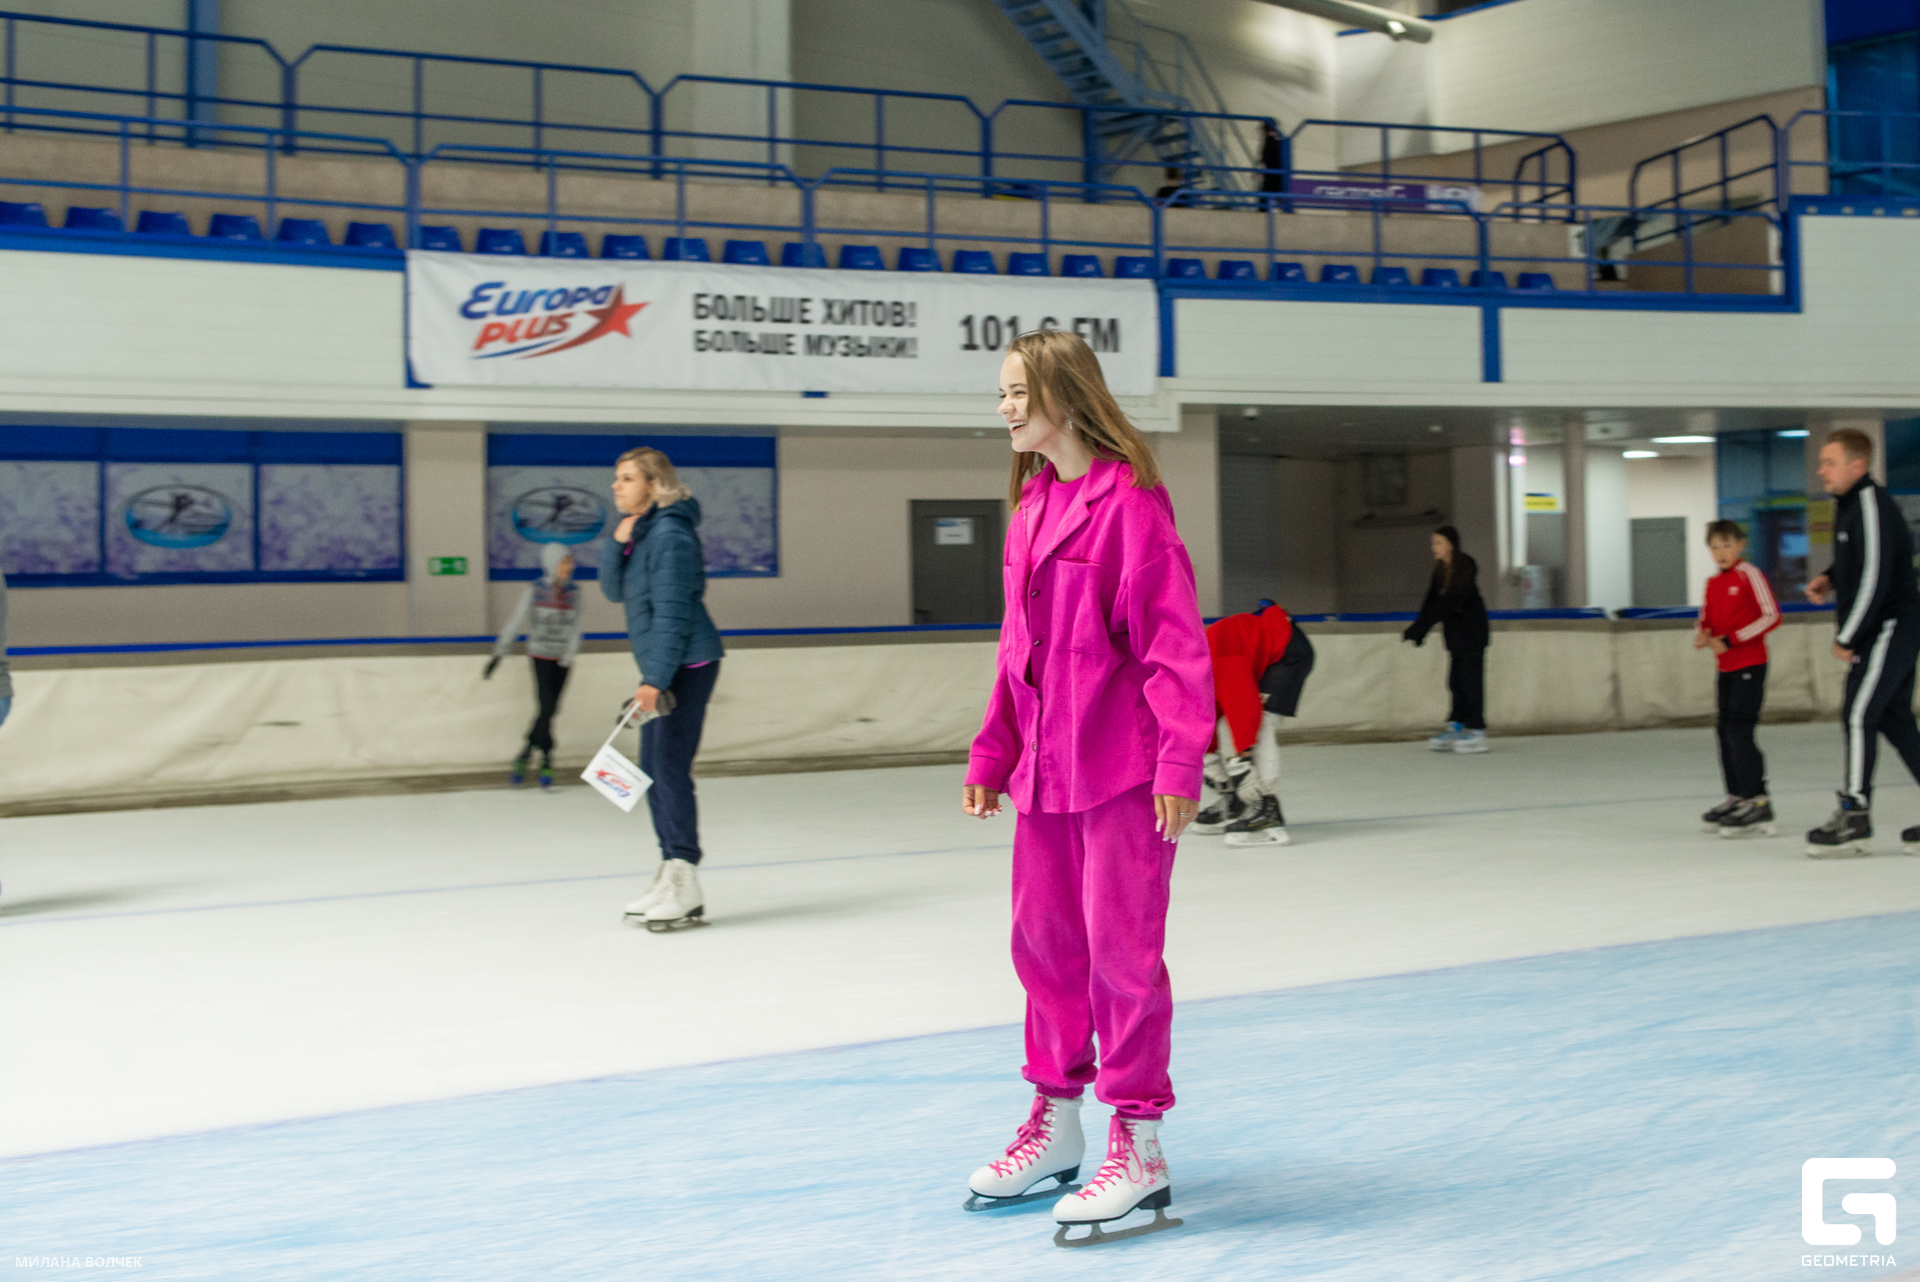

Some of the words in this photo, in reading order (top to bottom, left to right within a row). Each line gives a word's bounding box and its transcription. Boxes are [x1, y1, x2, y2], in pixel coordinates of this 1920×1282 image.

[460, 281, 614, 320] Europa
[693, 293, 812, 324] БОЛЬШЕ
[819, 298, 918, 328] ХИТОВ!
[693, 330, 799, 356] БОЛЬШЕ
[805, 334, 918, 359] МУЗЫКИ!
[1072, 317, 1121, 353] FM
